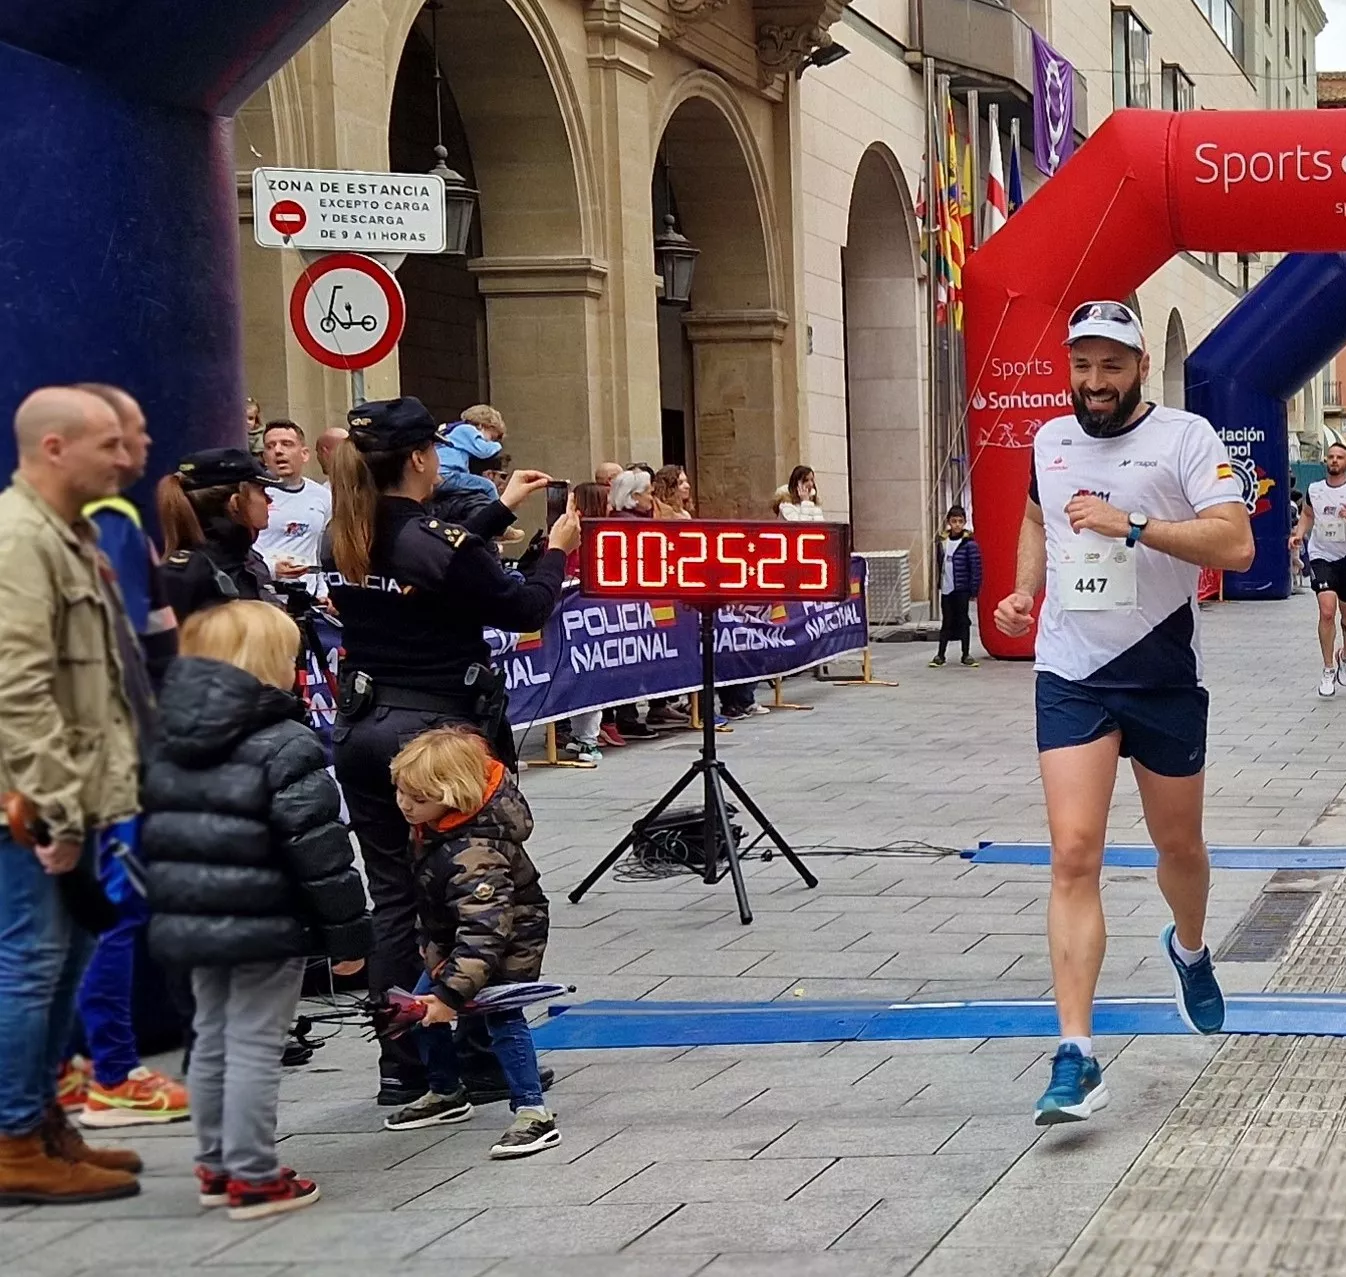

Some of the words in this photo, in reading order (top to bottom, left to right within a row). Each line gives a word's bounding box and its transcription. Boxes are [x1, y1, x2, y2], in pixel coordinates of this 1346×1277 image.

[1195, 142, 1332, 193] Sports
[269, 179, 314, 192] ZONA
[320, 182, 340, 193] DE
[347, 183, 430, 197] ESTANCIA
[320, 199, 379, 210] EXCEPTO
[384, 201, 430, 212] CARGA
[321, 213, 327, 222] Y
[333, 214, 404, 225] DESCARGA
[320, 230, 336, 239] DE
[342, 231, 348, 239] 9
[354, 231, 362, 239] A
[367, 231, 377, 240] 11
[382, 232, 426, 241] HORAS
[991, 357, 1053, 380] Sports
[989, 390, 1073, 409] Santande
[1217, 426, 1265, 441] dación
[1227, 442, 1251, 458] pol
[596, 531, 828, 590] 00:25:25
[1075, 578, 1108, 593] 447
[570, 631, 679, 675] NACIONAL
